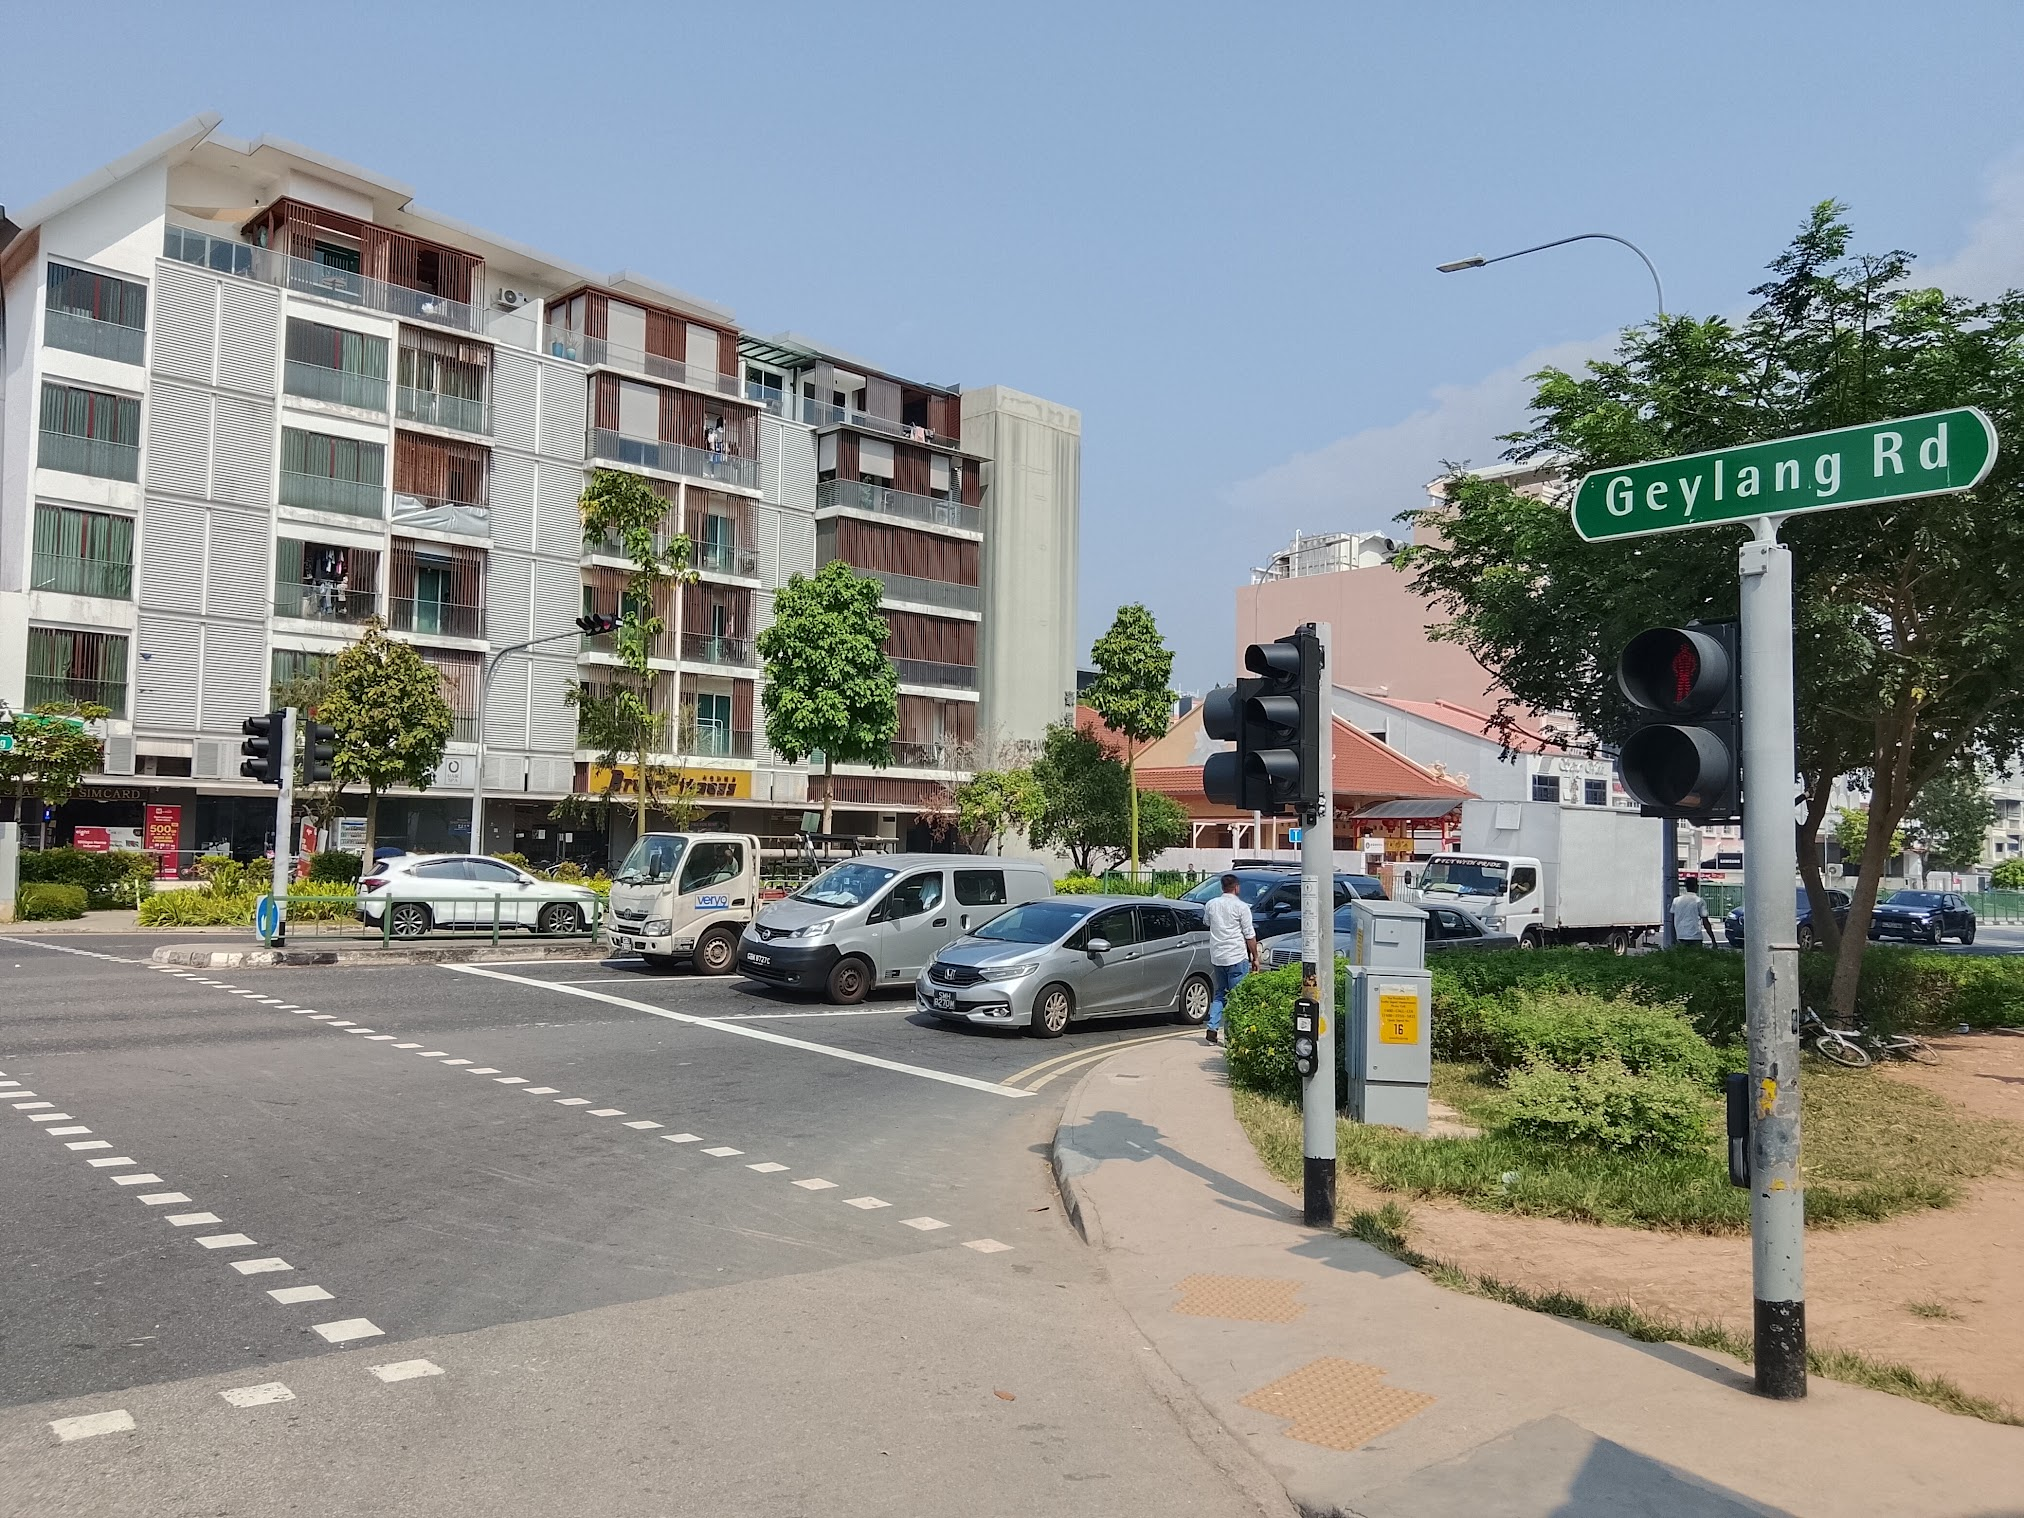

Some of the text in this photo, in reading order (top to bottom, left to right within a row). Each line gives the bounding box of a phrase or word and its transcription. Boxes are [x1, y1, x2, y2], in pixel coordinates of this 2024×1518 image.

[1605, 422, 1948, 517] Geylang Rd
[78, 787, 141, 799] SIMCARD
[150, 824, 171, 834] 500
[938, 991, 951, 999] SMH
[1393, 1023, 1404, 1035] 16
